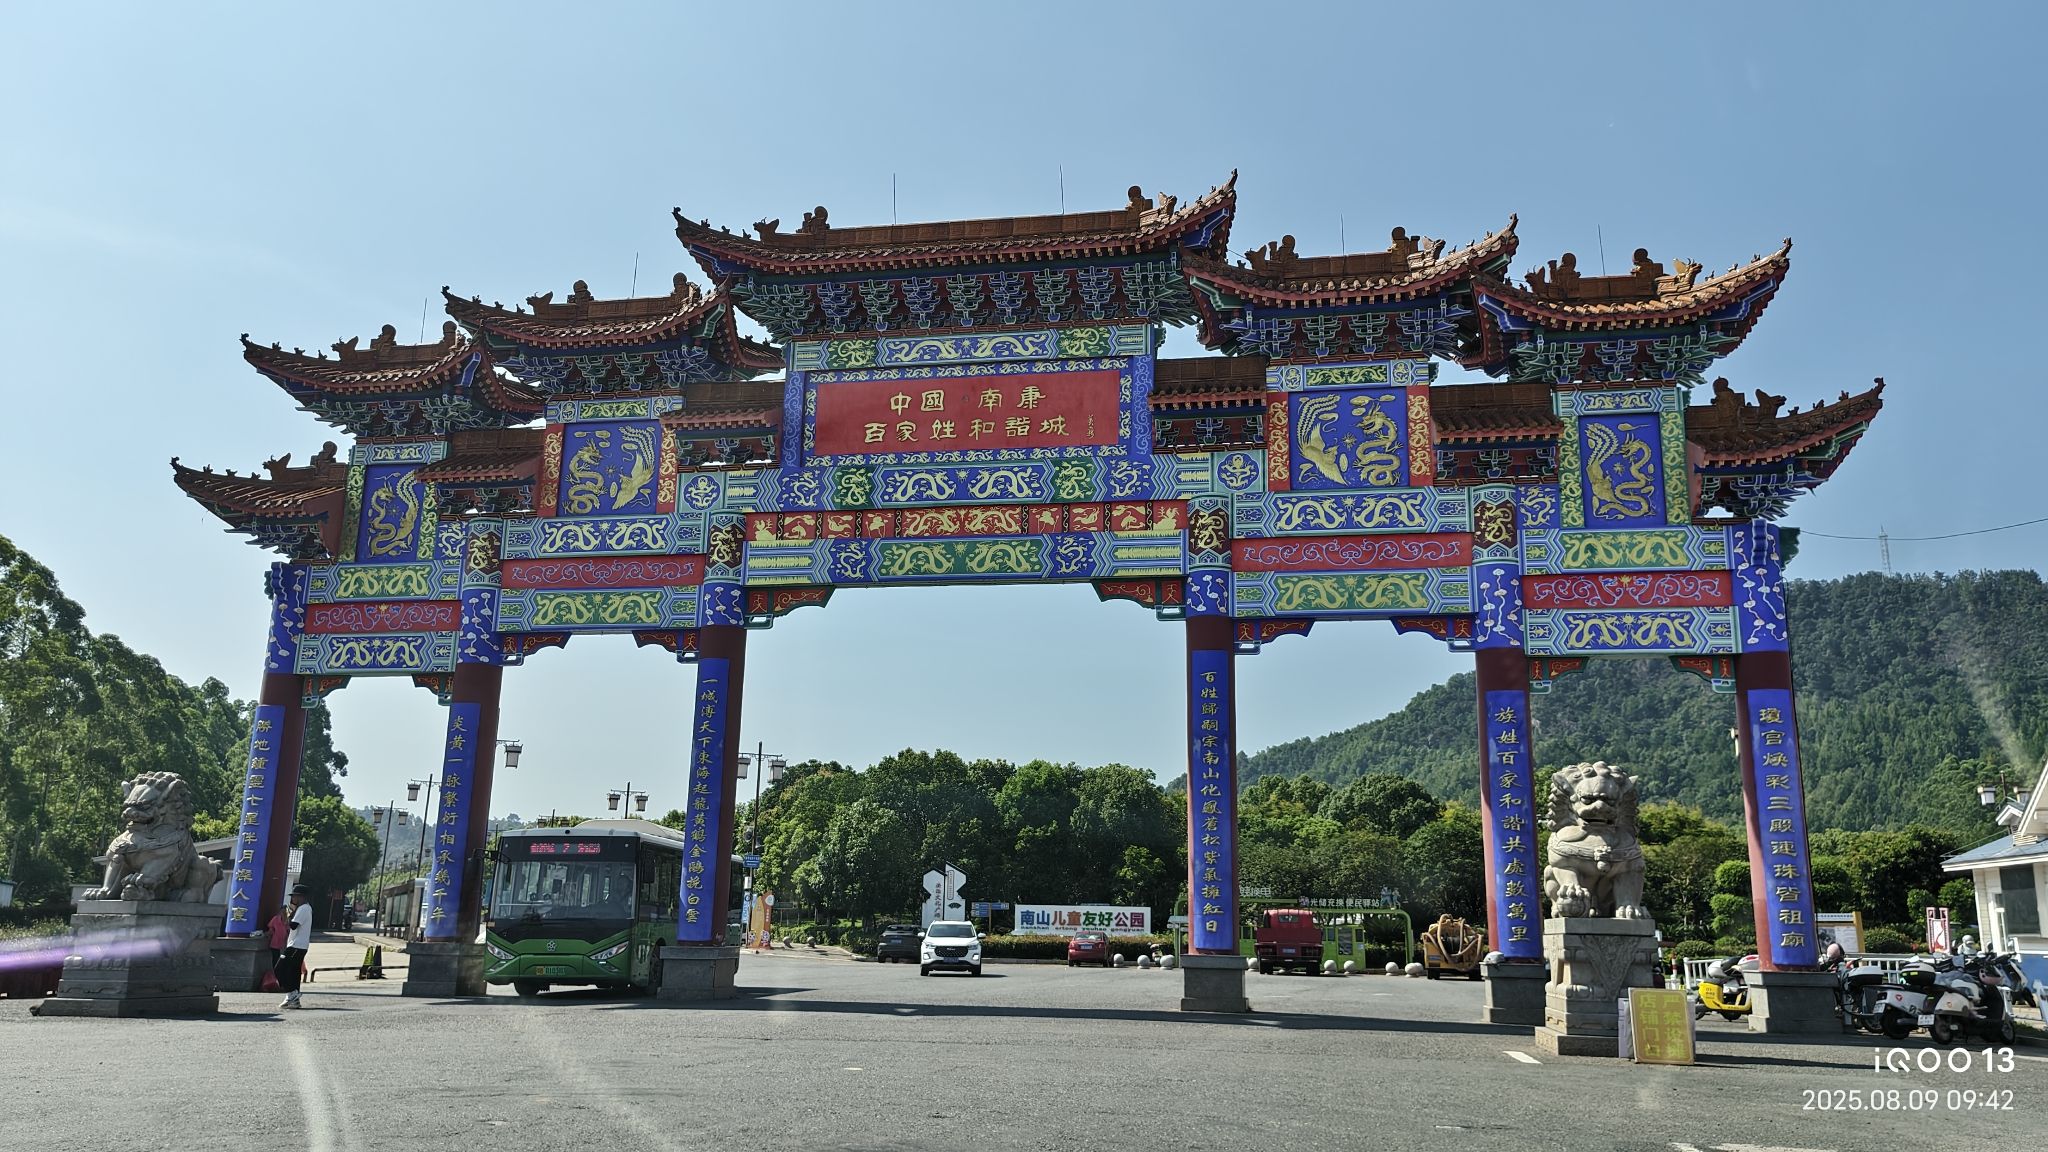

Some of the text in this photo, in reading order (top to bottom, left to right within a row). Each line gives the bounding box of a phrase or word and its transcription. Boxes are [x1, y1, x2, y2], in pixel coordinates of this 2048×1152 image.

[889, 385, 1046, 416] 中國 南康
[863, 414, 1070, 444] 百家姓和諧城
[1020, 910, 1145, 928] 南山儿童友好公园
